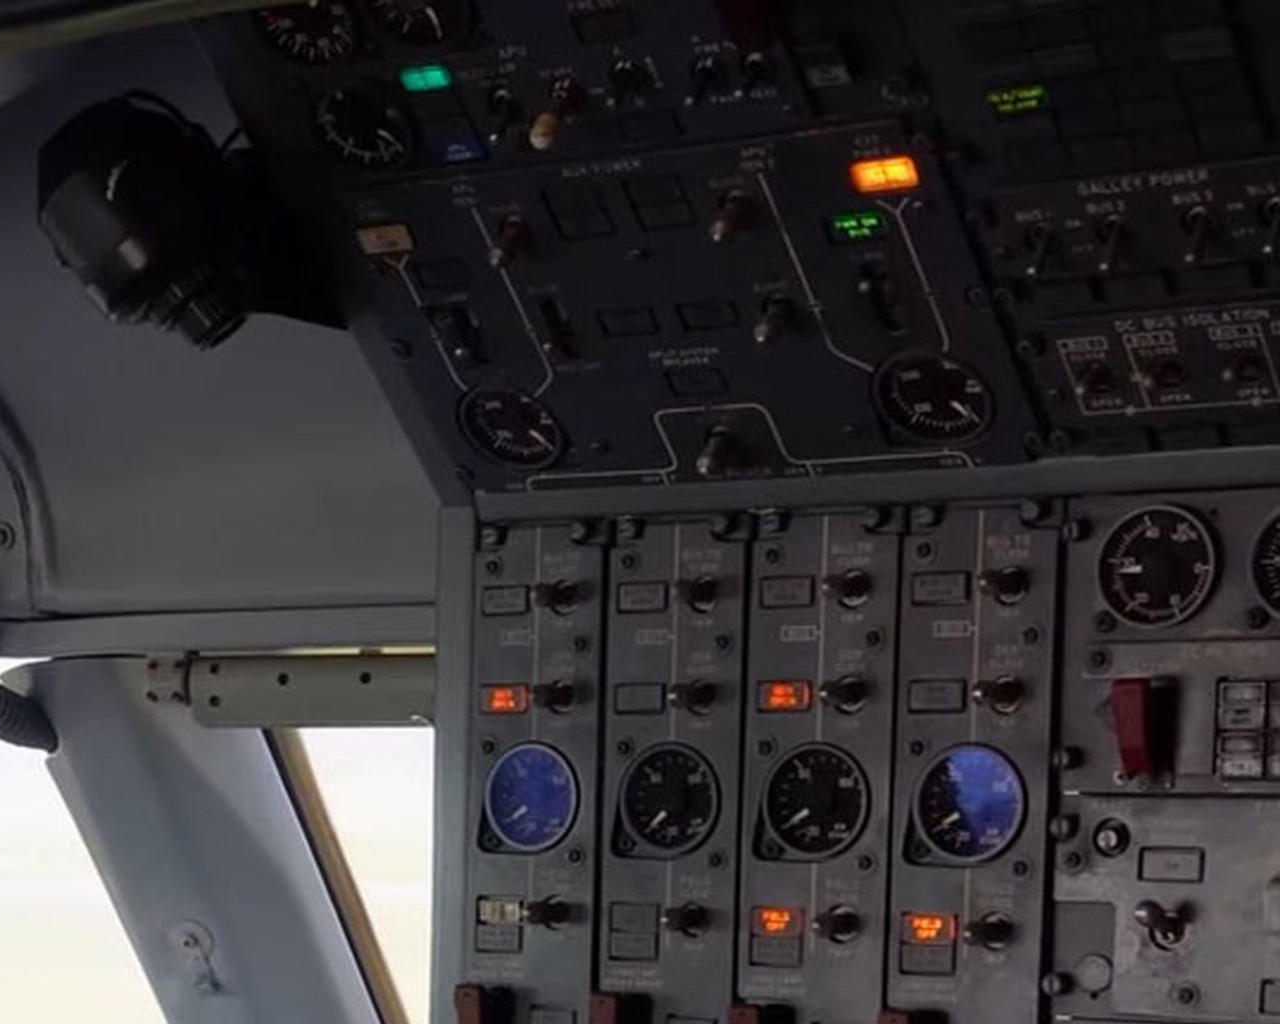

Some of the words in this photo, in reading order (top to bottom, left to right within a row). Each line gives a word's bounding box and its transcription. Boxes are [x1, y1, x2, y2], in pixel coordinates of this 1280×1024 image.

[1077, 175, 1141, 196] GALLEY
[1148, 168, 1209, 187] POWER
[1114, 319, 1137, 333] DC
[1143, 315, 1177, 329] BUS
[1181, 308, 1271, 327] ISOLATION
[761, 910, 791, 922] FIELD
[766, 921, 787, 932] OFF
[912, 917, 943, 930] FIELD
[916, 930, 938, 940] OFF
